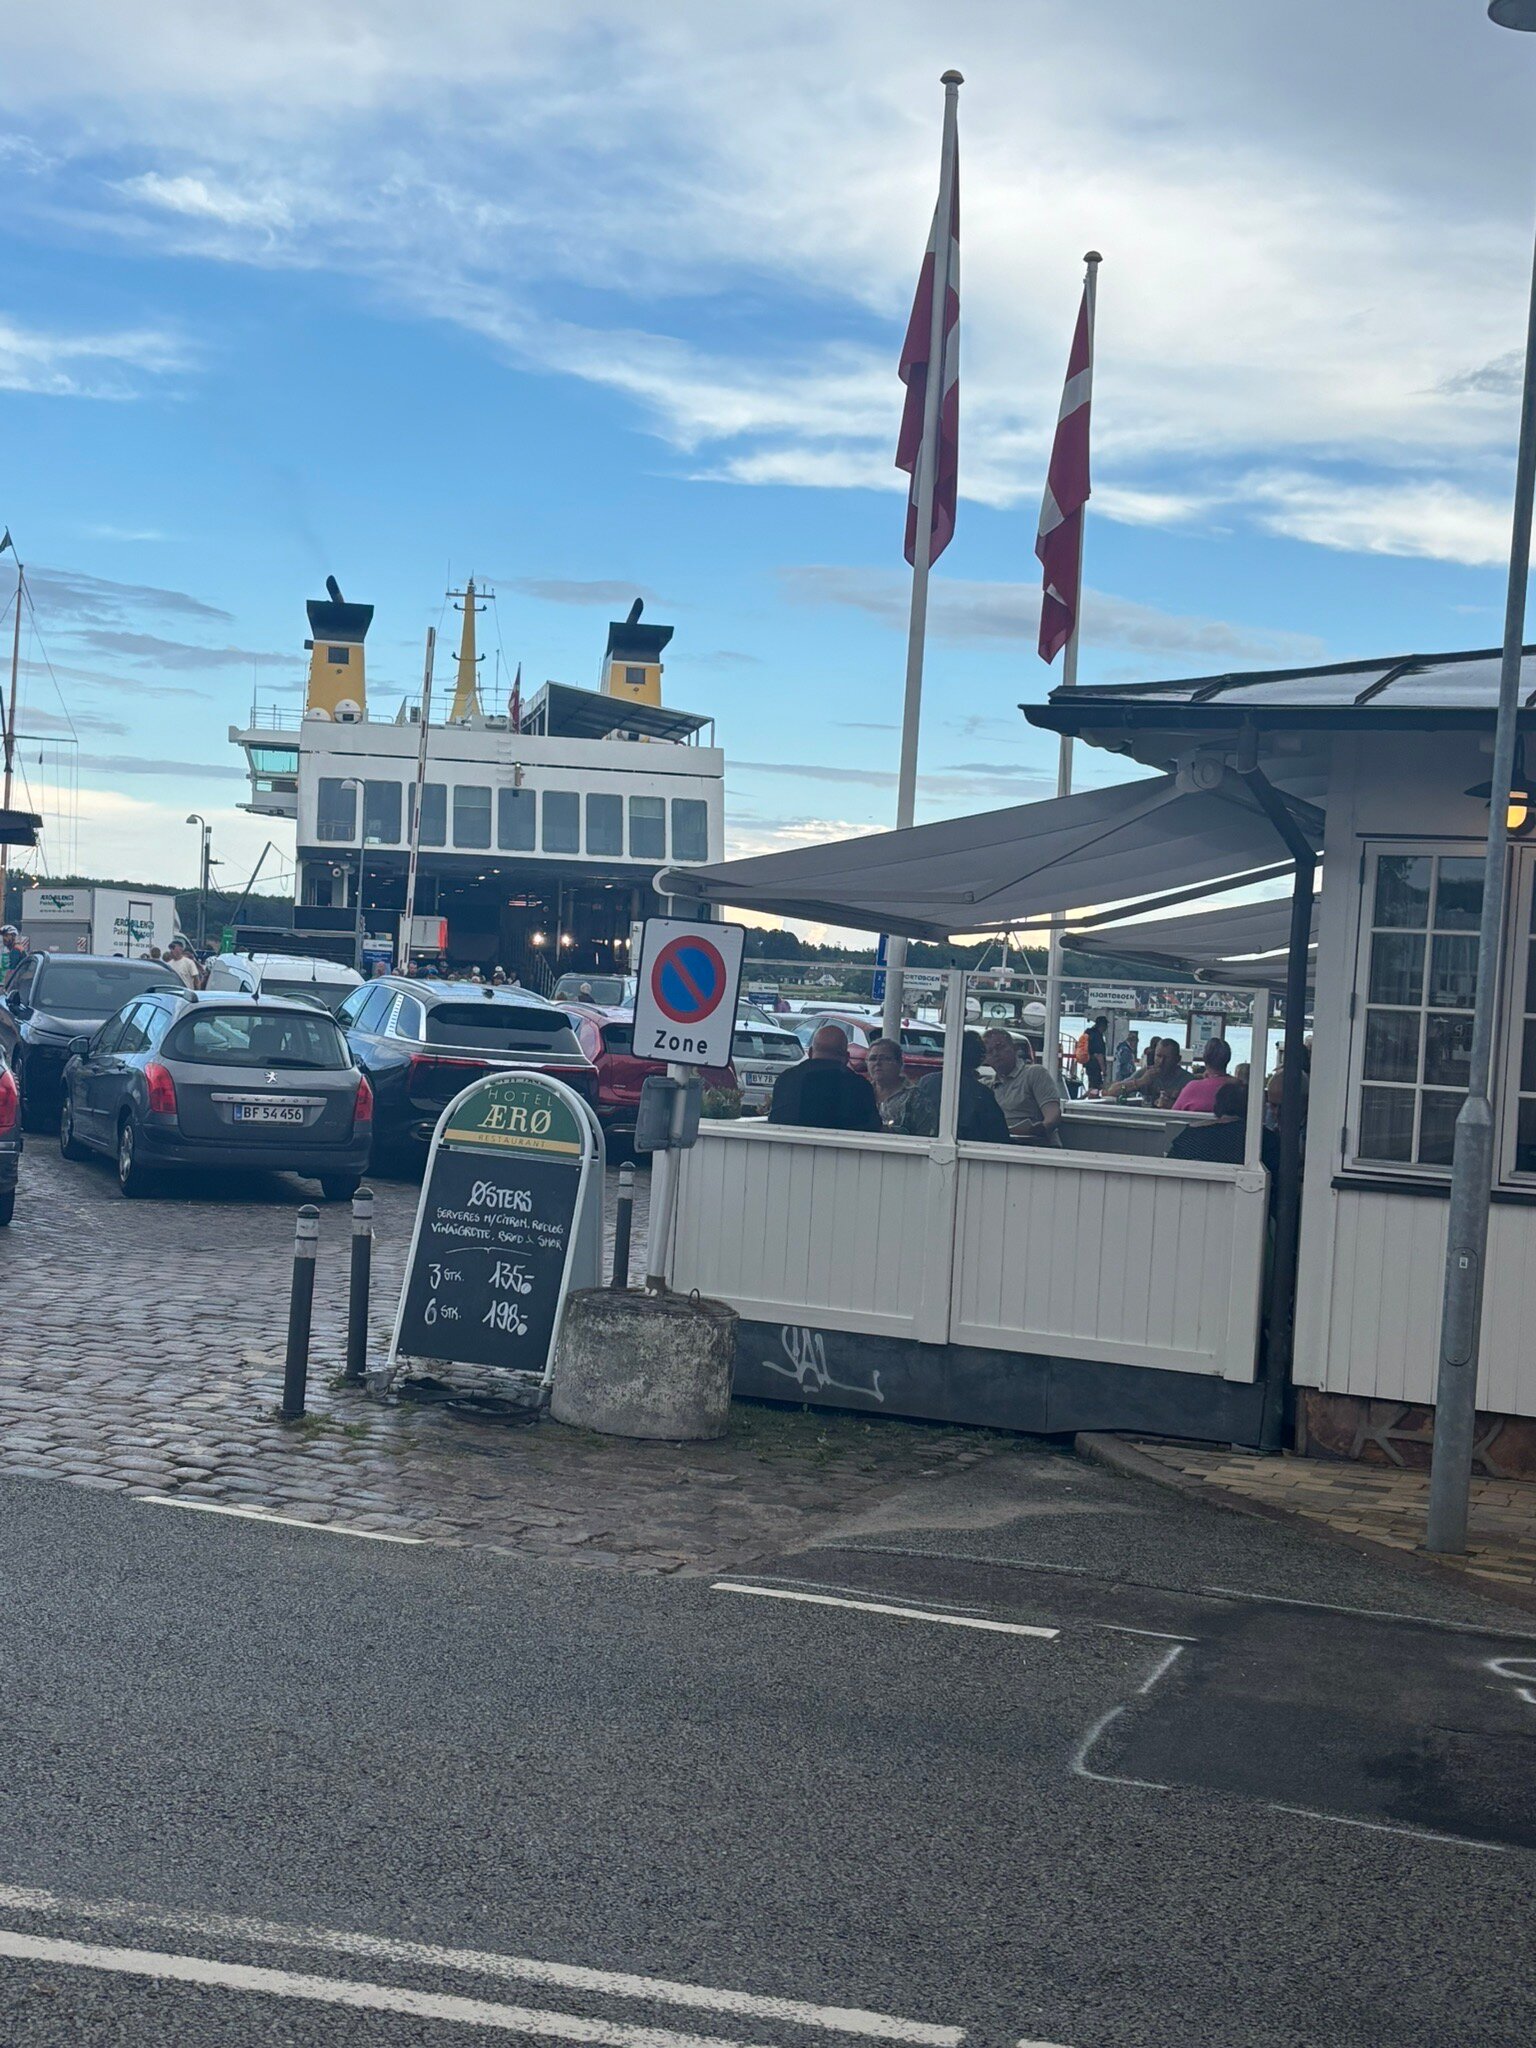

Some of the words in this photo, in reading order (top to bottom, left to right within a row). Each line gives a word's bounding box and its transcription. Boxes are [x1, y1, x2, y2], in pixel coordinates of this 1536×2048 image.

[654, 1030, 708, 1054] Zone
[488, 1089, 553, 1106] HOTEL
[243, 1106, 259, 1118] BF
[262, 1108, 277, 1119] 54
[280, 1109, 301, 1120] 456
[477, 1104, 552, 1134] ÆRØ
[478, 1134, 546, 1148] RESTAURANT
[467, 1180, 532, 1212] ØSTERS
[437, 1207, 480, 1222] SERVERES
[429, 1264, 441, 1289] 3
[444, 1268, 464, 1281] STK.
[424, 1297, 437, 1325] 6
[440, 1304, 461, 1320] STK.
